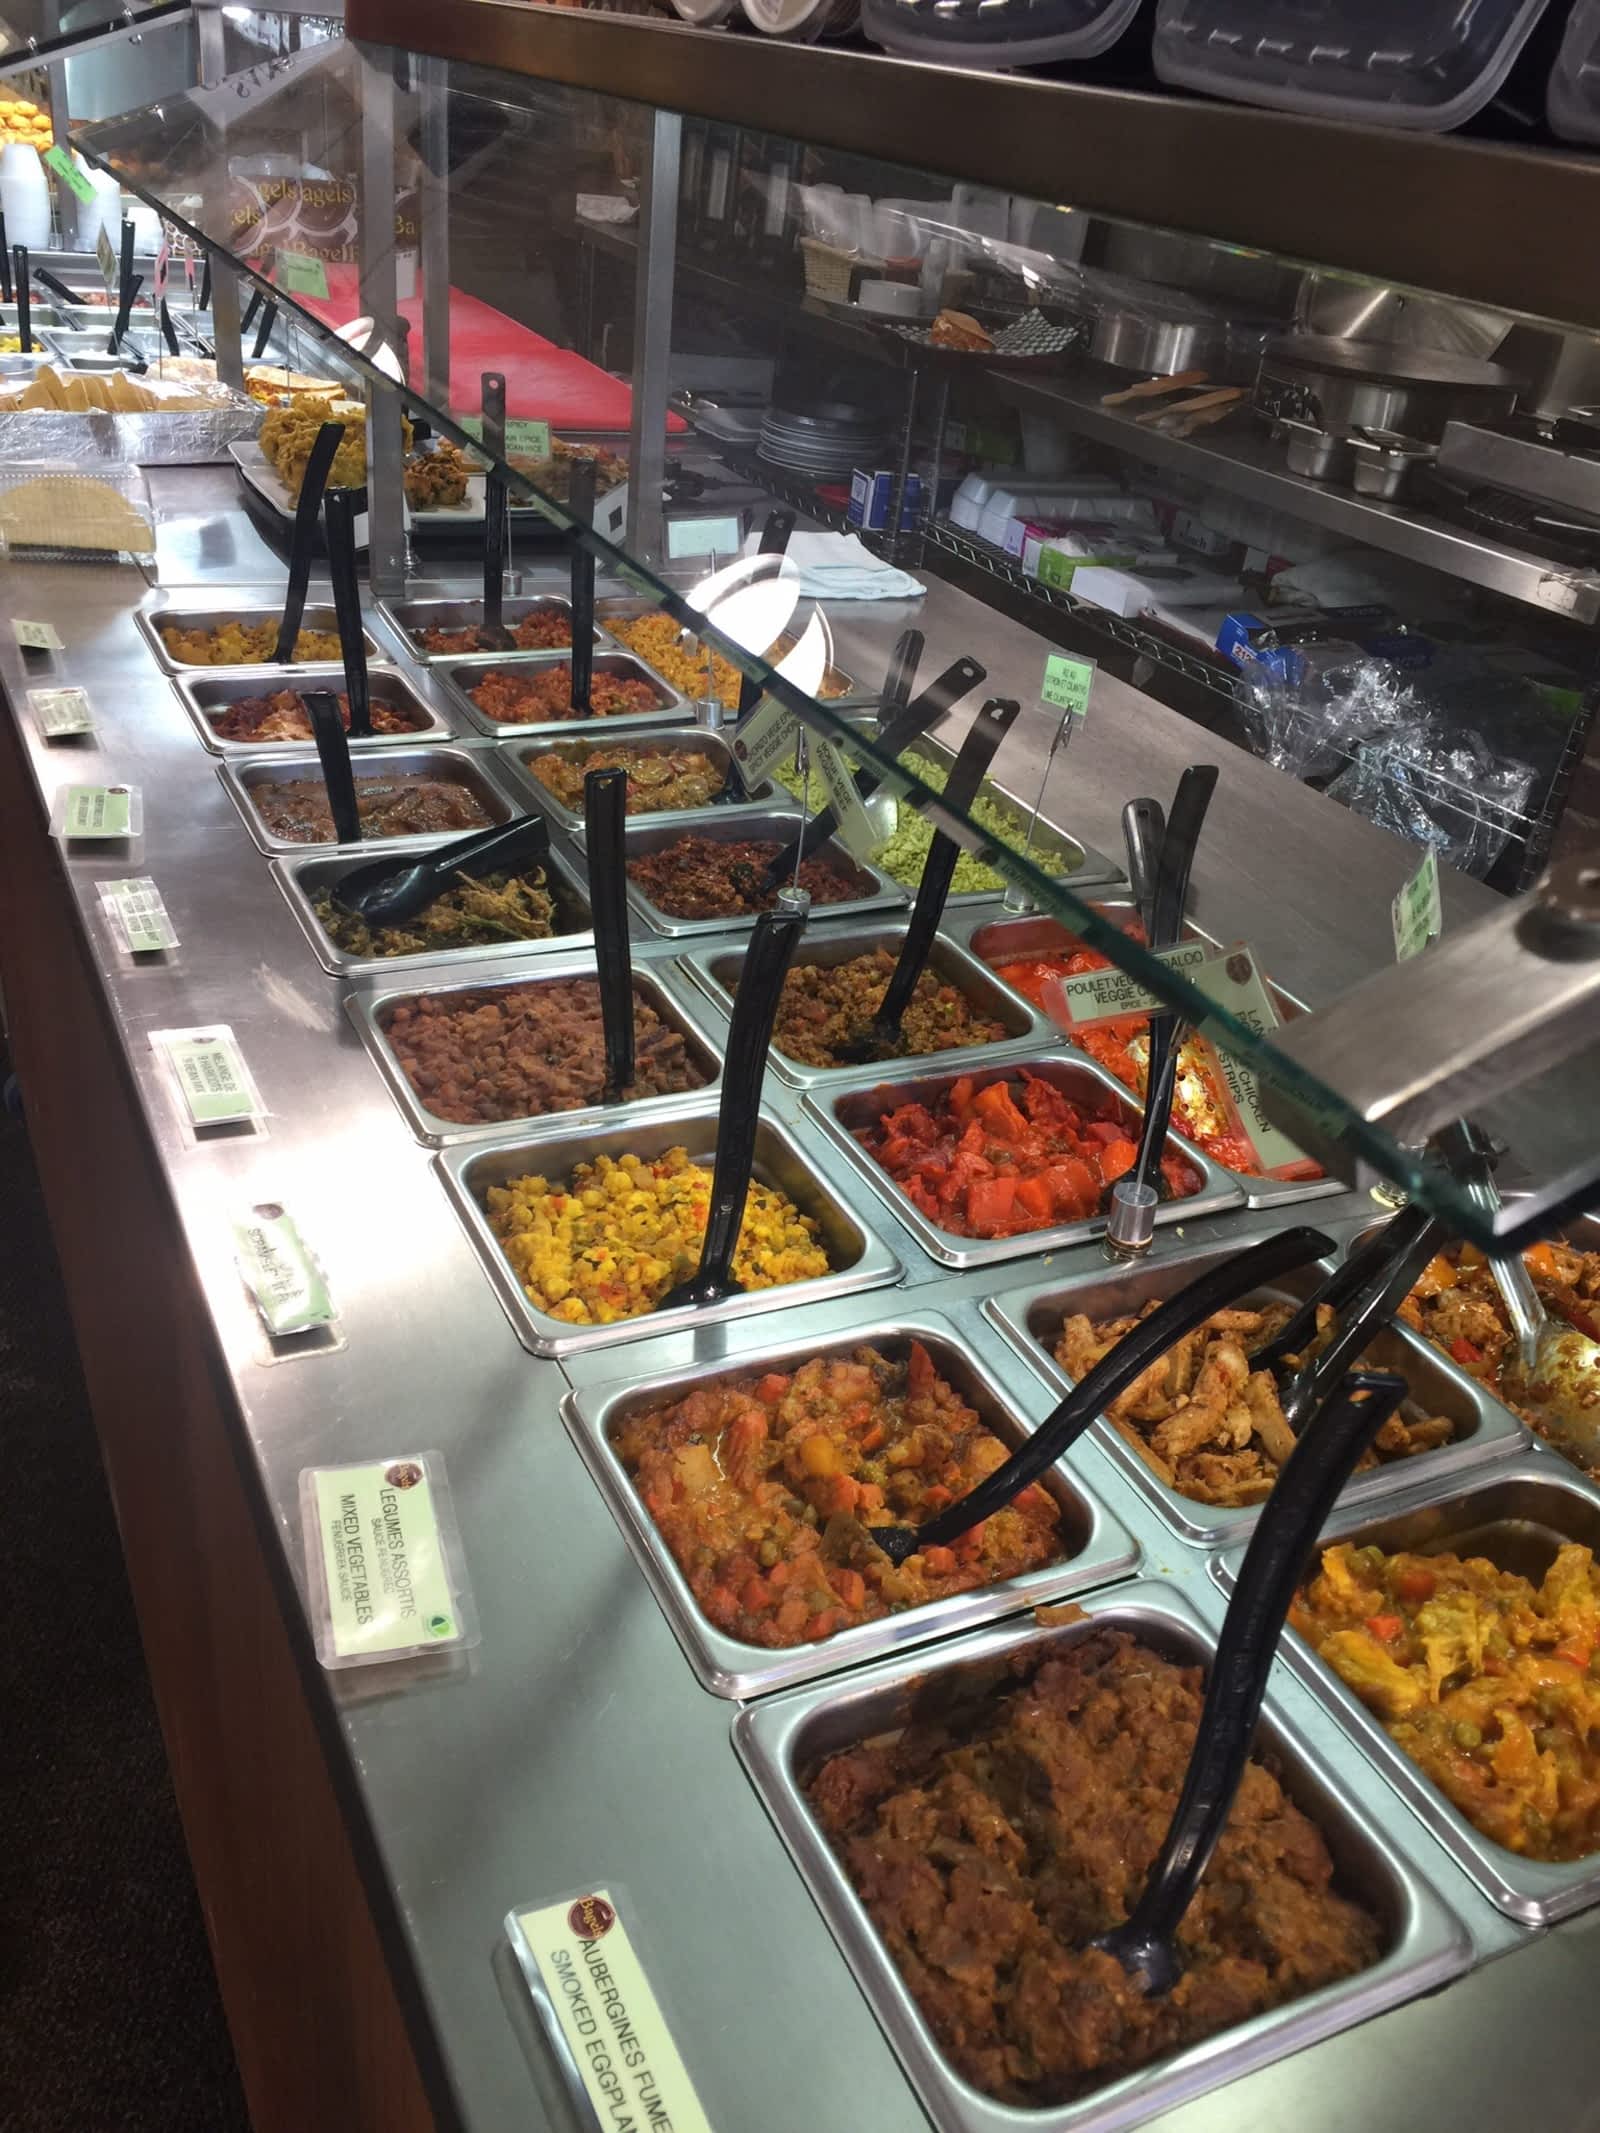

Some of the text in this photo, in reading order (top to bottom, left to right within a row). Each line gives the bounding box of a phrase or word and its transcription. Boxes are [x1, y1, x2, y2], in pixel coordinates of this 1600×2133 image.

[1066, 977, 1110, 996] POULET
[1094, 988, 1135, 1004] VEGGIE
[1218, 1053, 1245, 1105] STRIPS
[1238, 1071, 1272, 1134] CHICKEN
[331, 1519, 353, 1603] FENUGREEK SAUCE
[340, 1493, 374, 1625] MIXED VEGETABLES
[371, 1517, 386, 1546] SAUCE
[379, 1487, 417, 1619] LEGUMES ASSORTIS
[578, 1897, 605, 1939] Bagels
[550, 1949, 598, 2037] SMOKED
[577, 1938, 646, 2069] AUBERGINES
